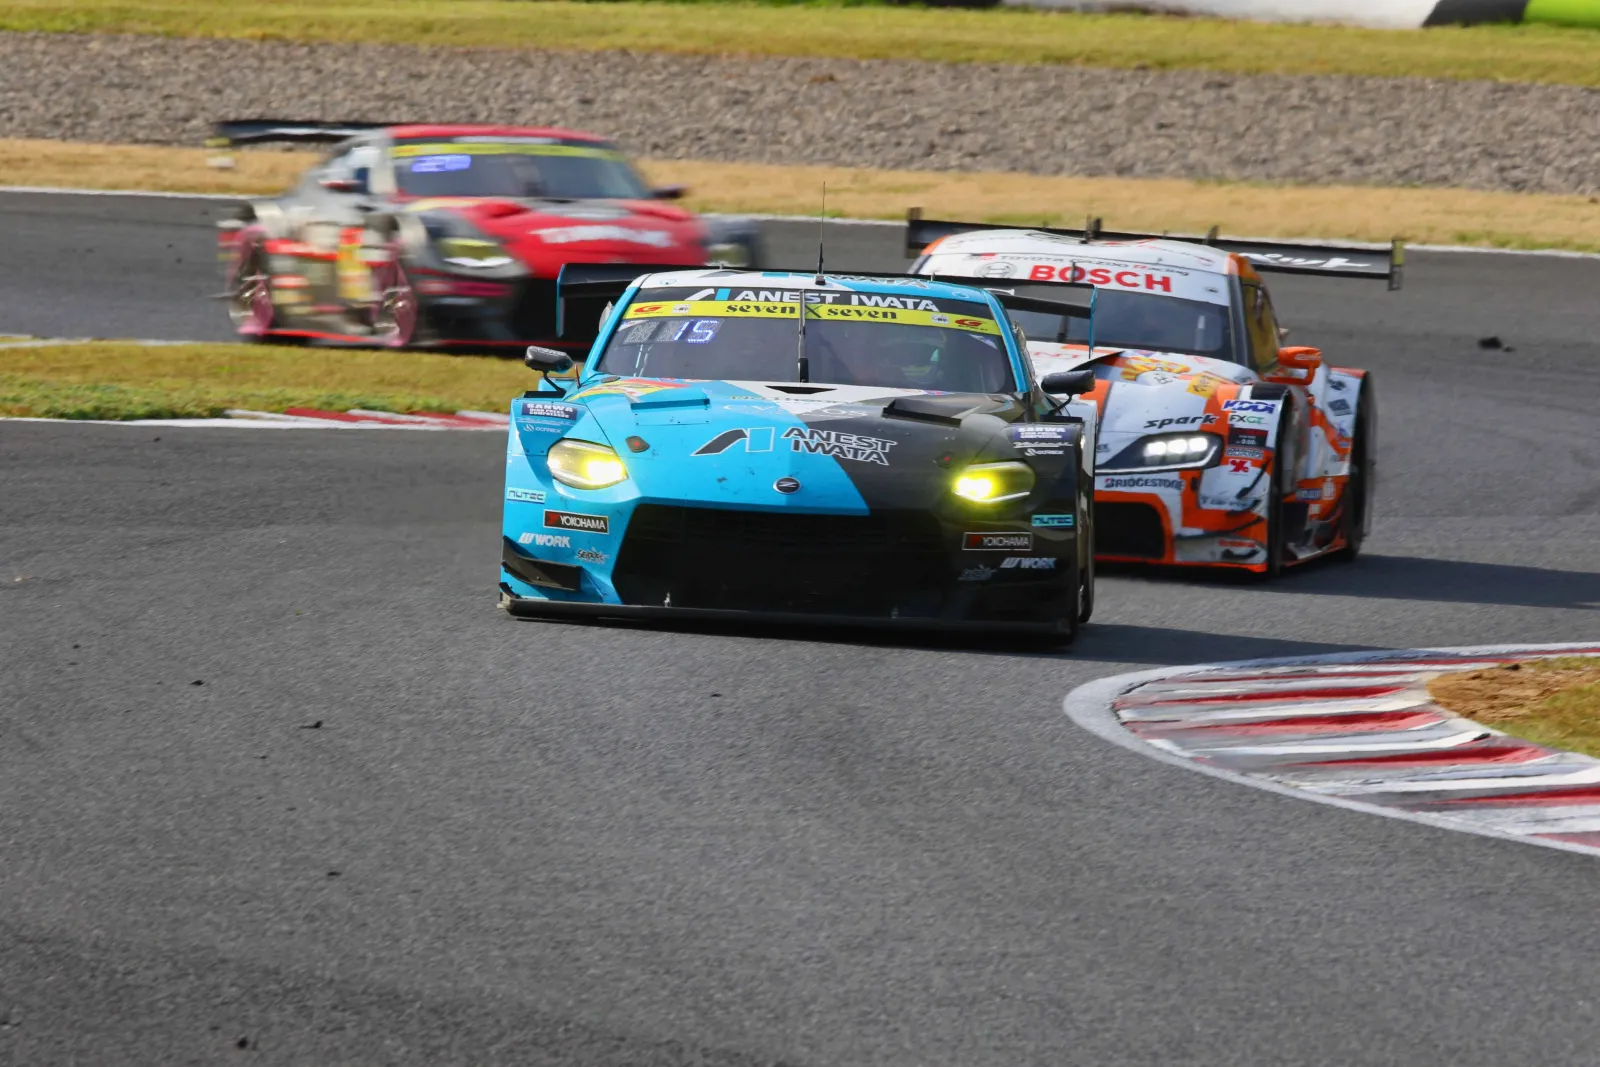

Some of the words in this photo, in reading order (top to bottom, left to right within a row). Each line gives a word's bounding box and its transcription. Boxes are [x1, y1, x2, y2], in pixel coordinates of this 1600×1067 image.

[1029, 264, 1173, 293] BOSCH
[734, 290, 840, 304] ANEST
[850, 294, 940, 312] IWATA
[725, 304, 796, 314] seven
[826, 307, 899, 319] seven
[1143, 414, 1217, 429] spark
[781, 427, 898, 453] ANEST
[792, 440, 889, 466] IWATA
[1104, 477, 1185, 491] BRIDGESTONE
[560, 515, 606, 530] YOKOHAMA
[535, 533, 571, 549] WORK
[982, 536, 1029, 547] YOKOHAMA
[1020, 557, 1058, 569] WORK
